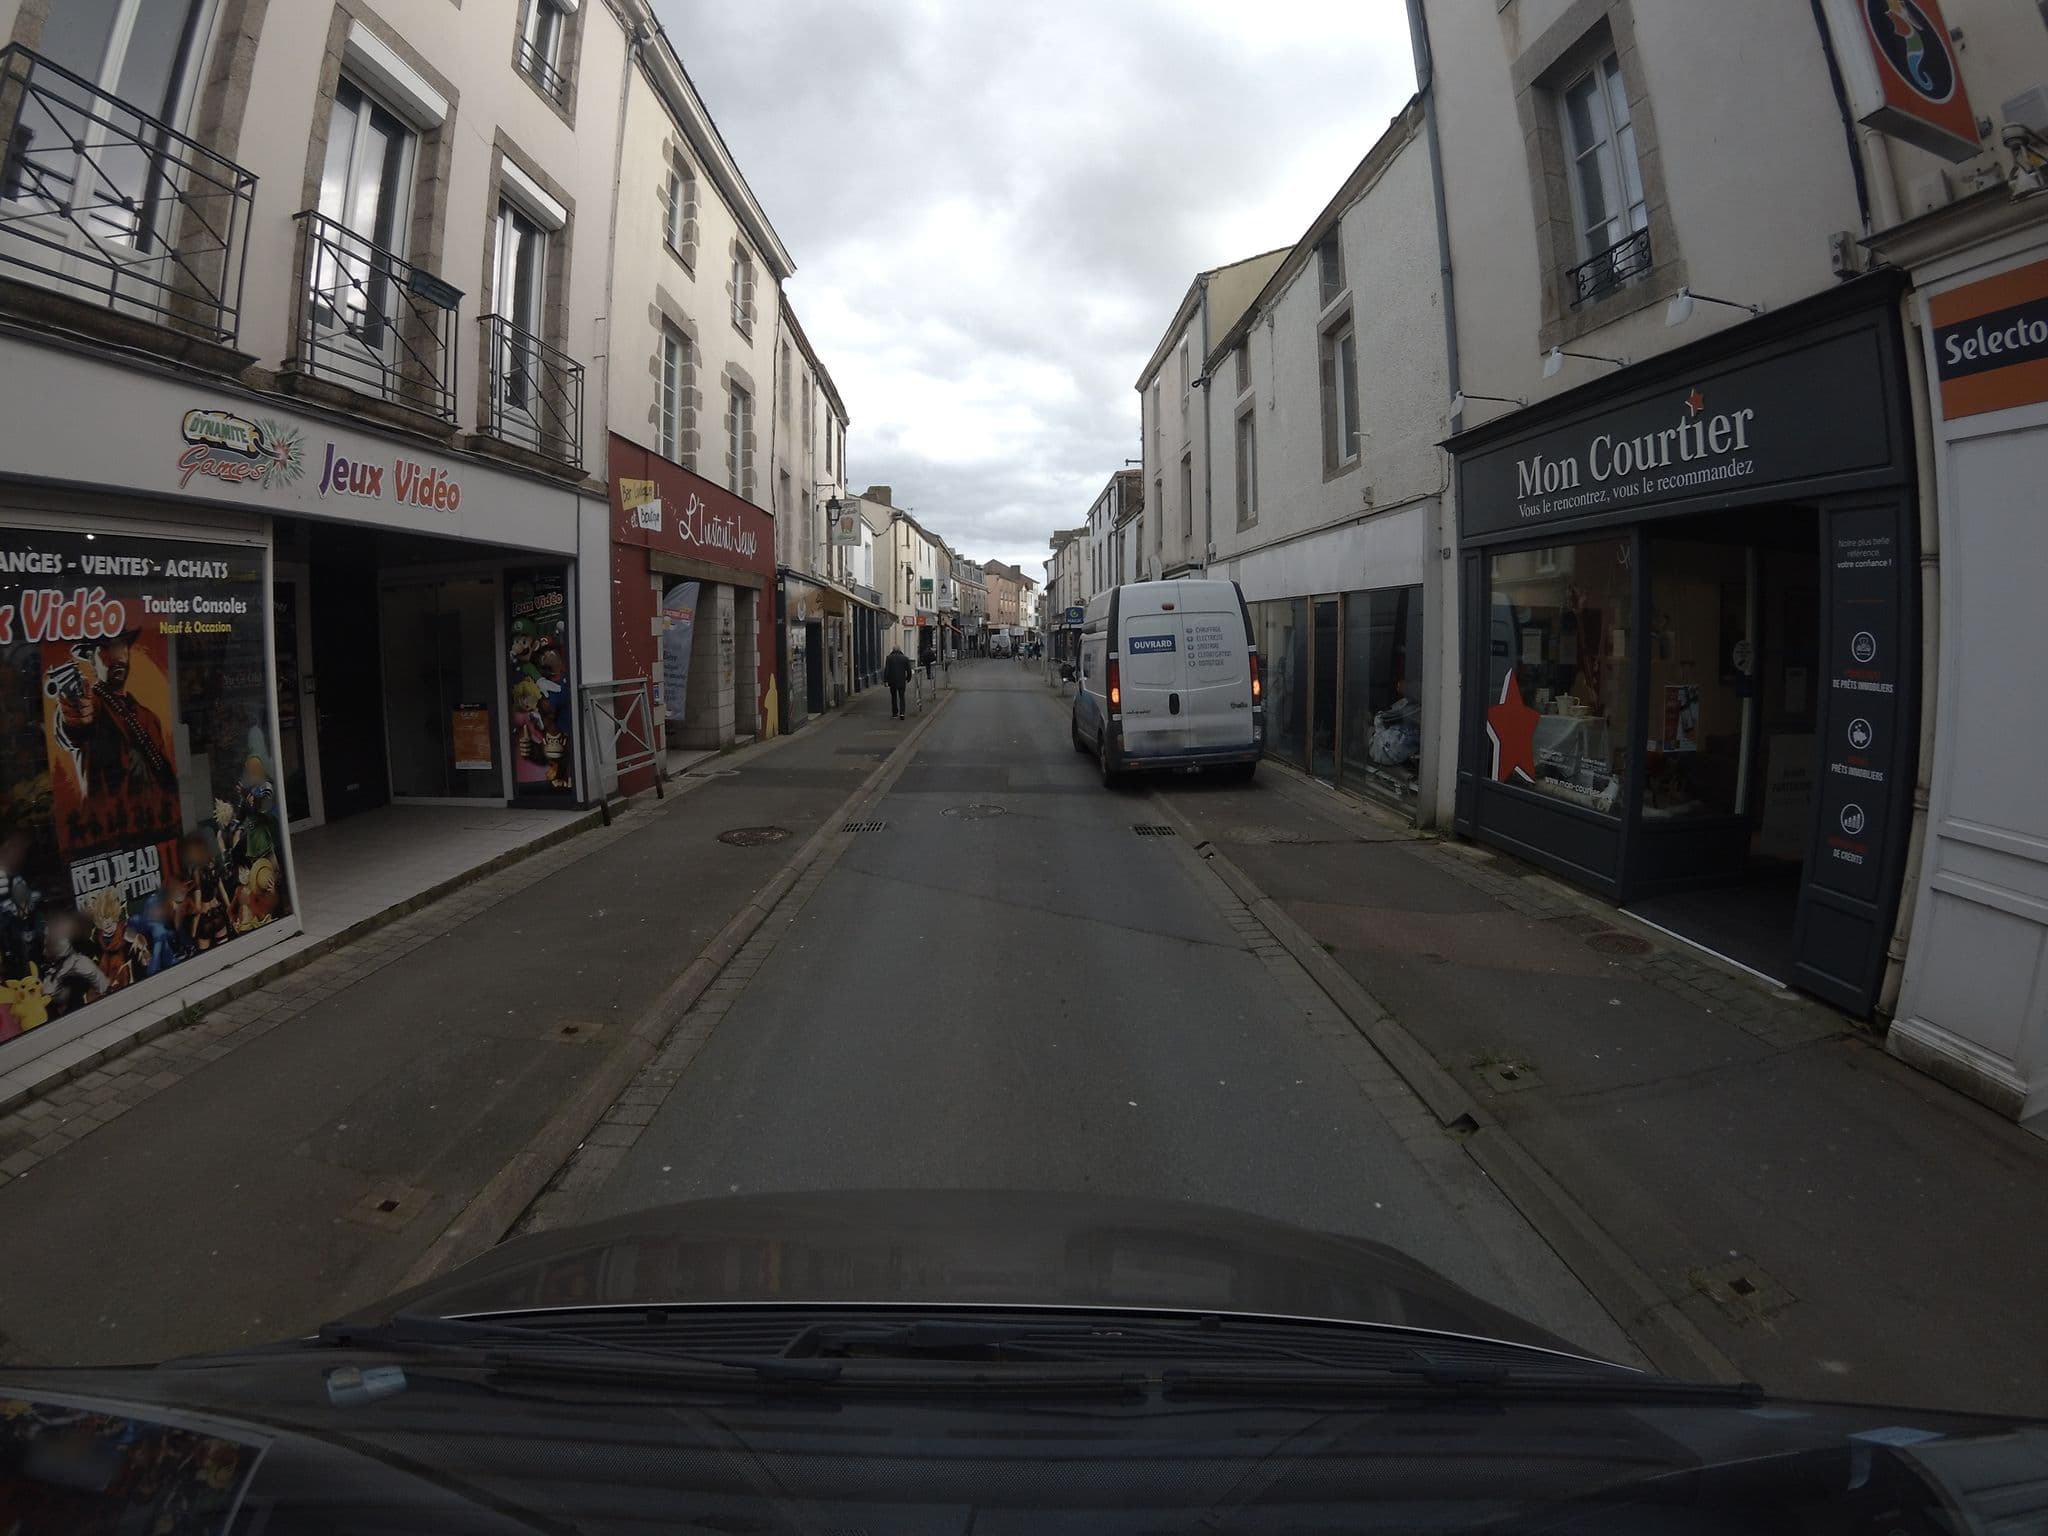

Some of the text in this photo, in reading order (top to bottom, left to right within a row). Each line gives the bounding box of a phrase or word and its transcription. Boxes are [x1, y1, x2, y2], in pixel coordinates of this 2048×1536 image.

[1945, 318, 2048, 364] Selecto
[188, 416, 249, 444] DYNAMITE
[178, 444, 266, 489] Games
[1516, 407, 1754, 499] Mon Courtier
[318, 442, 462, 512] Jeux Vidéo
[1519, 458, 1754, 518] Vous le rencontrez, vous le recommandez
[81, 555, 150, 576] VENTES
[165, 560, 229, 579] ACHATS
[20, 586, 125, 643] Vidéo
[142, 595, 247, 614] Toutes Consoles
[160, 621, 232, 634] Neuf & Occasion
[1134, 639, 1173, 649] OUVRARD
[71, 859, 111, 897] RED
[111, 845, 160, 883] DEAD
